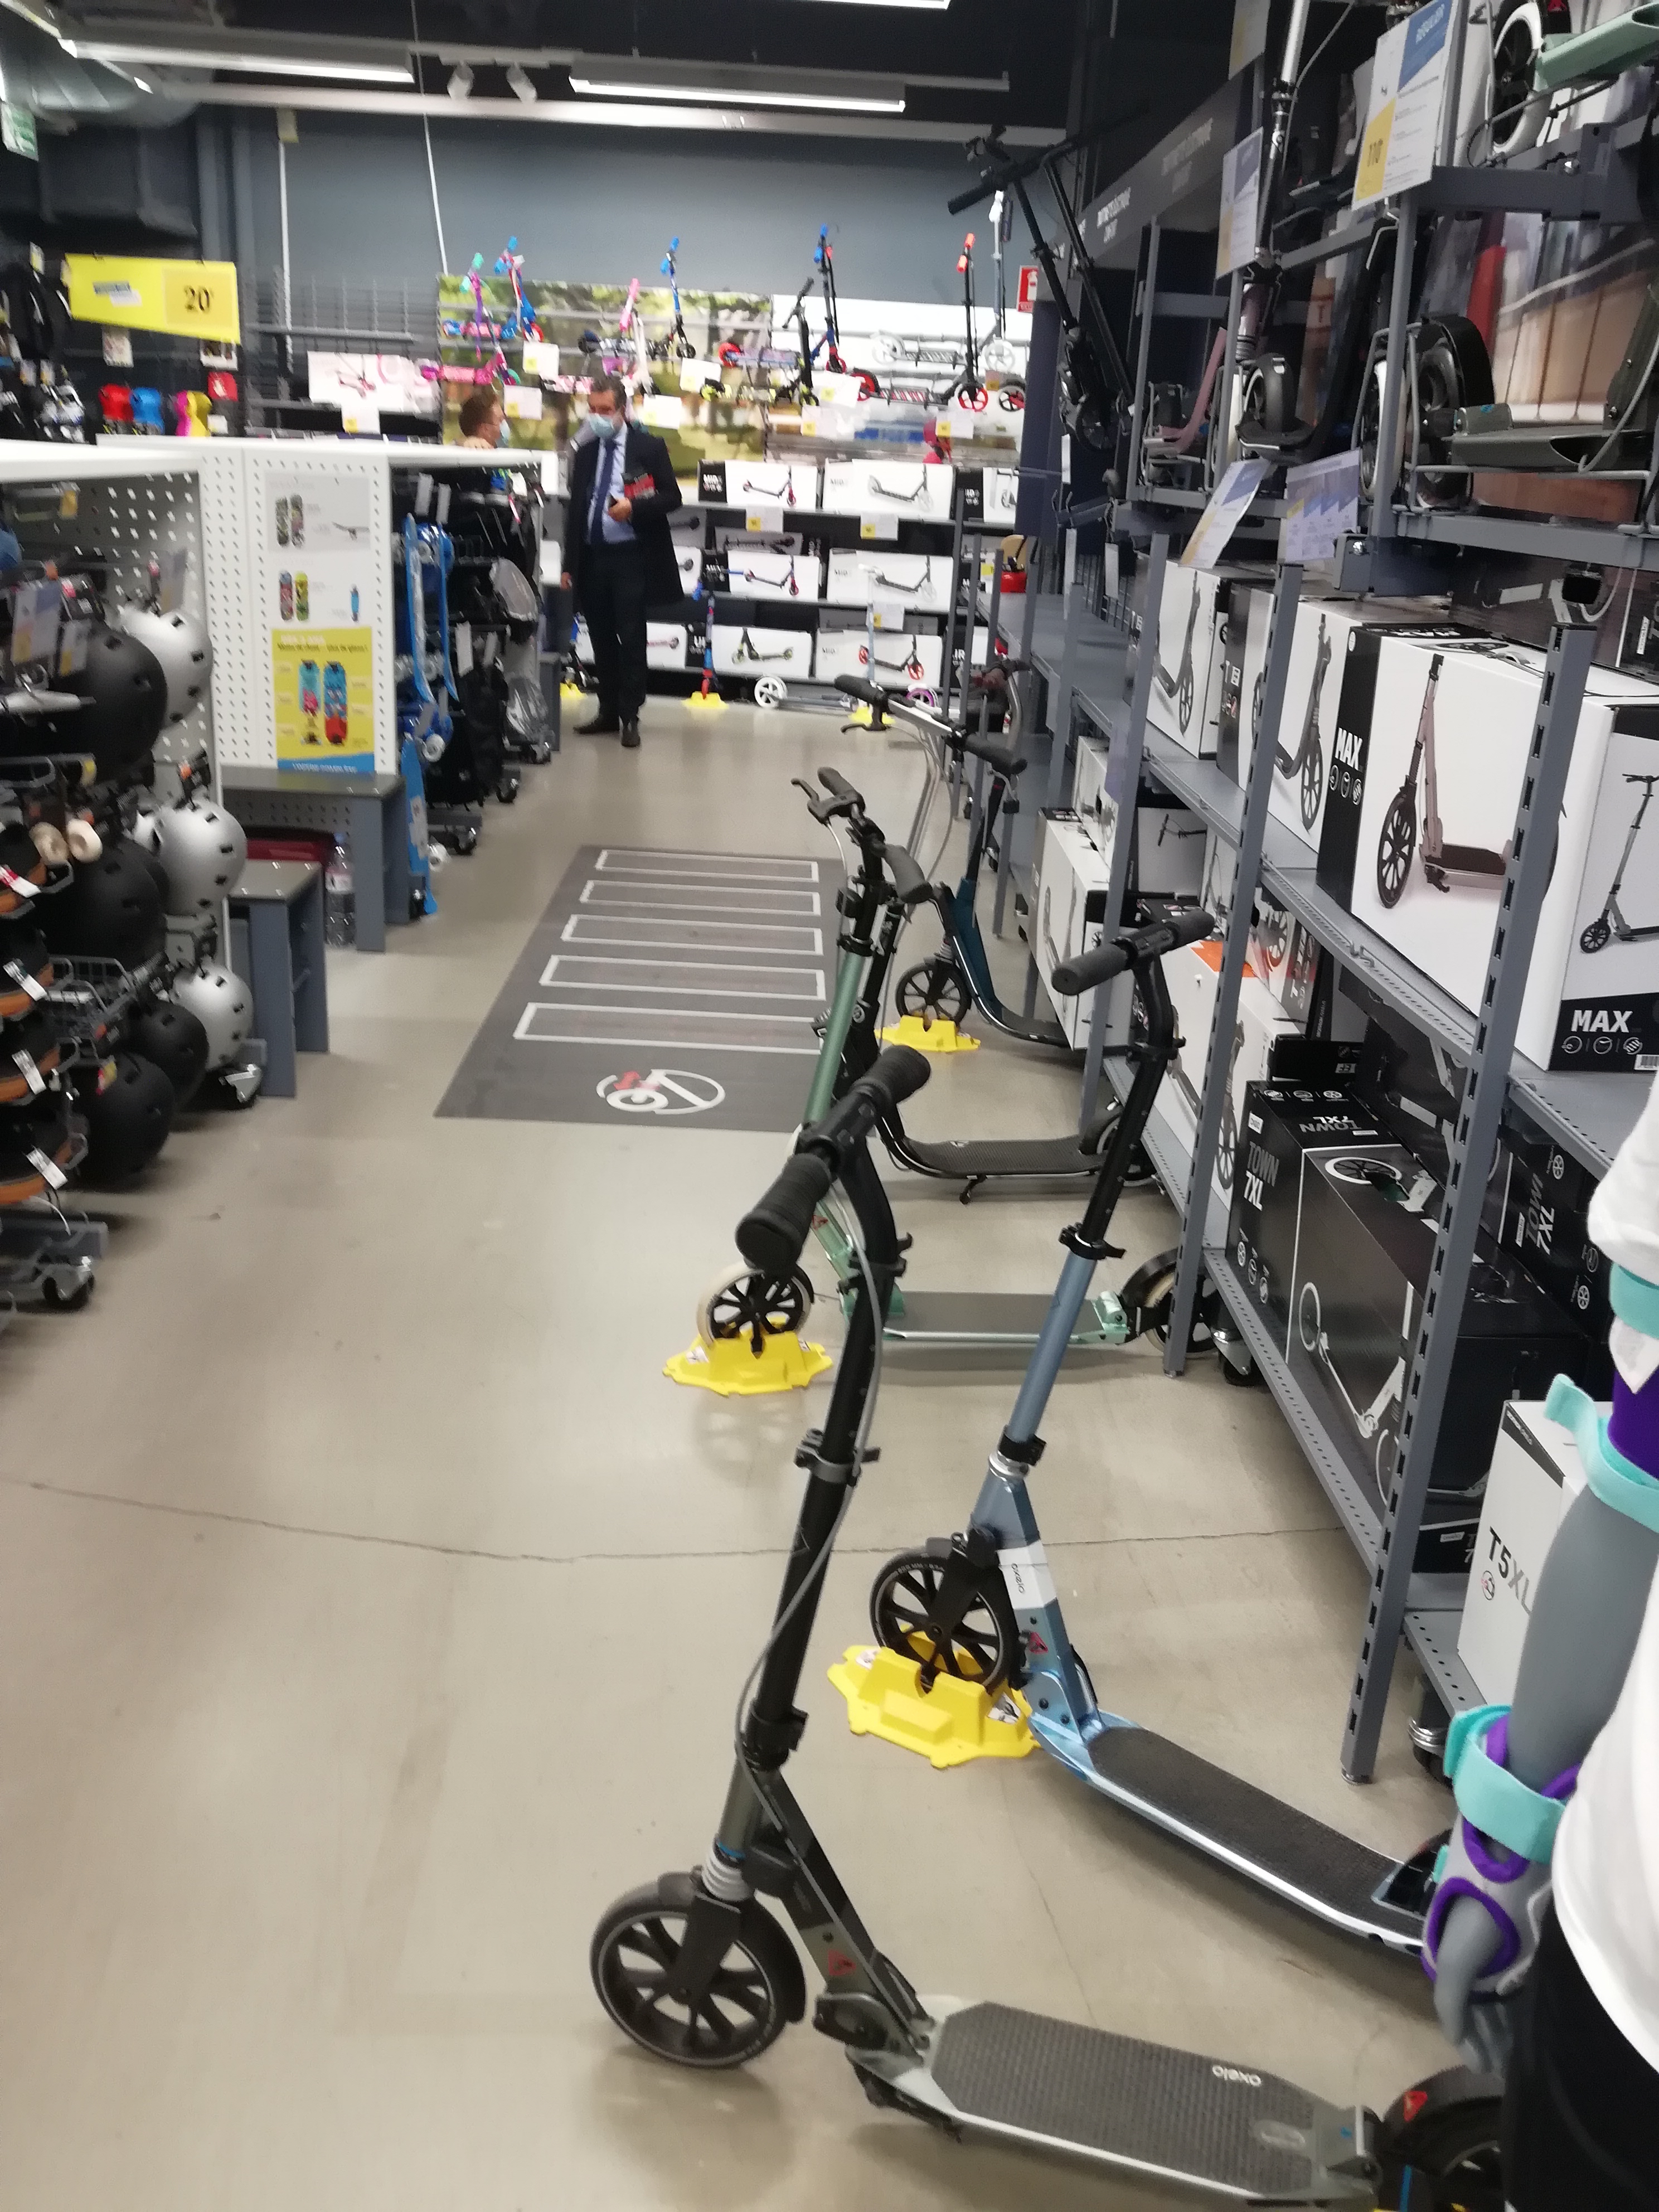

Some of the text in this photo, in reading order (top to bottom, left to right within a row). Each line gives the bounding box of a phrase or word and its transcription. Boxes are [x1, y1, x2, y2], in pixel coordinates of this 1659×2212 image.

[1335, 727, 1363, 770] MAX
[1570, 1009, 1633, 1033] MAX
[1298, 1119, 1362, 1133] TOWN
[1246, 1141, 1280, 1187] TOWN
[1244, 1170, 1264, 1211] 7XL
[1536, 1205, 1555, 1255] 7XL
[1489, 1526, 1532, 1614] T5XL
